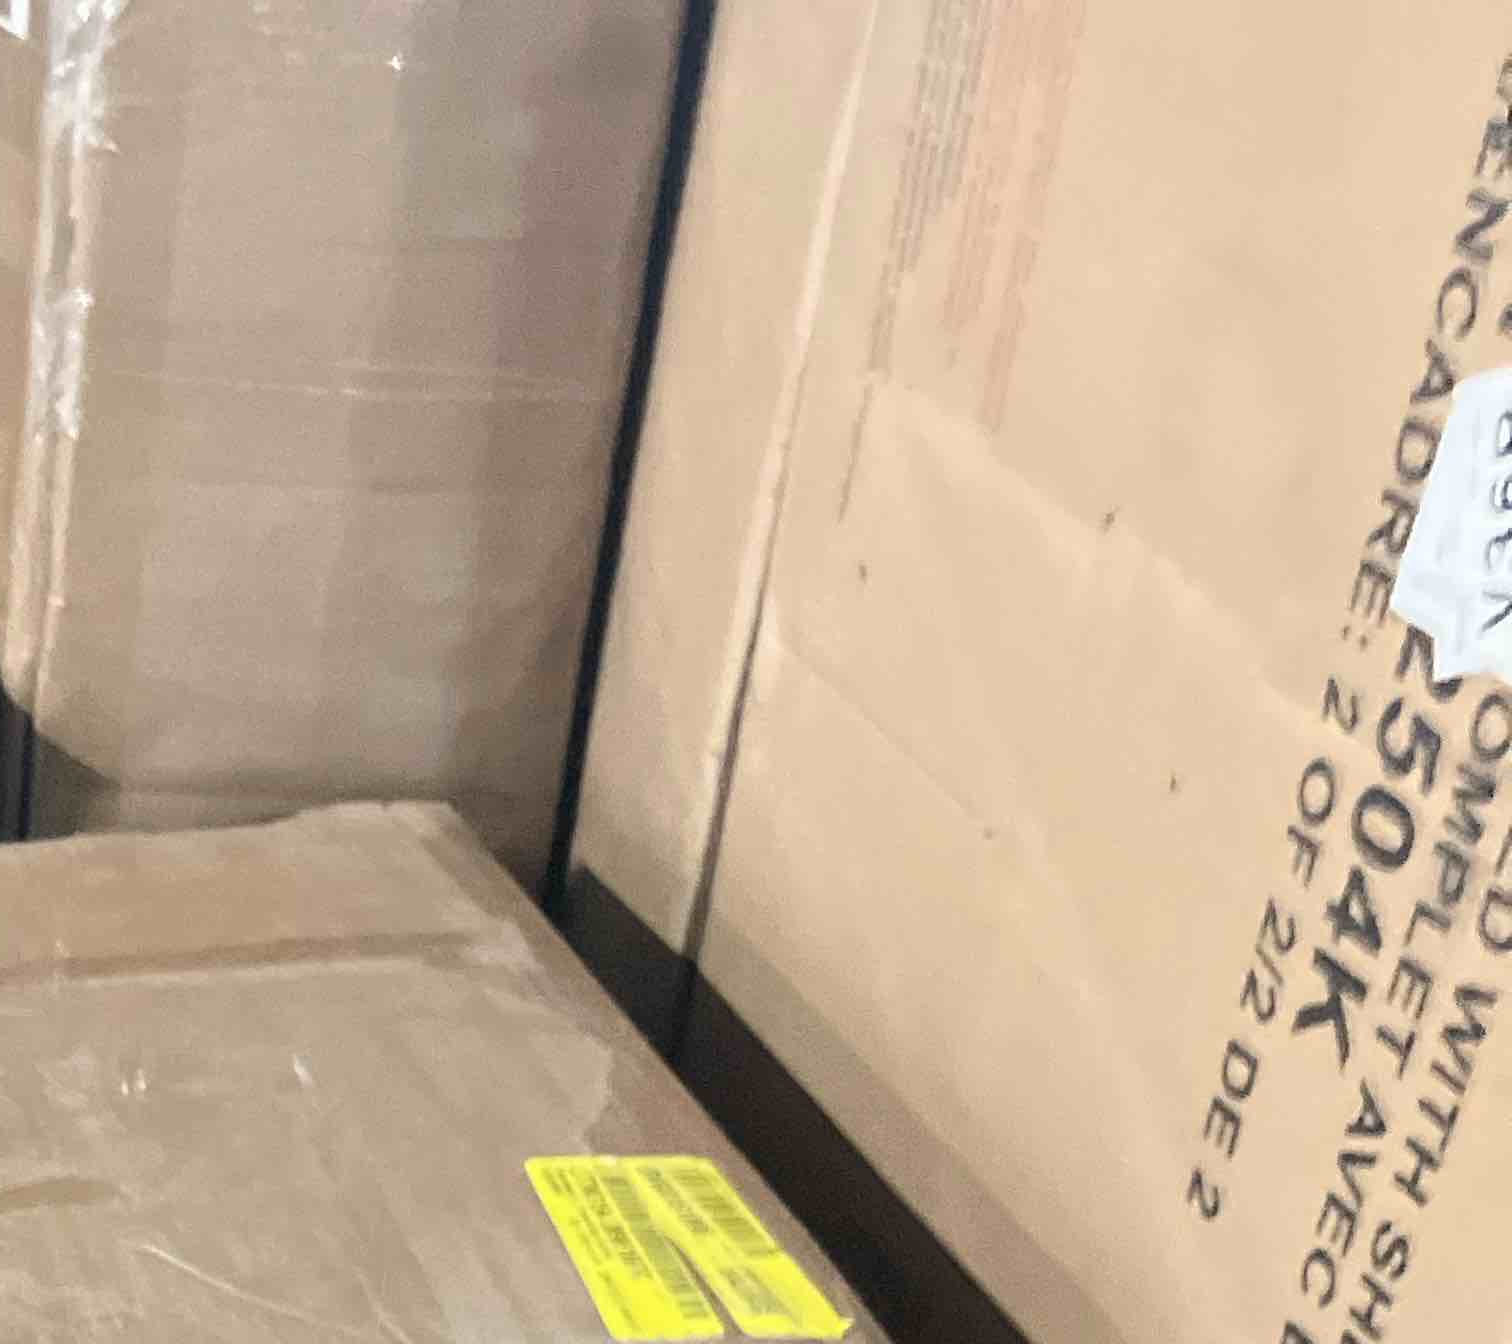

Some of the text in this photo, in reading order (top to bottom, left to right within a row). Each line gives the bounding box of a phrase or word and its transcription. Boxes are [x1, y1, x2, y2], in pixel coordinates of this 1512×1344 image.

[1322, 673, 1360, 735] 2
[1287, 756, 1337, 890] OF
[1376, 692, 1512, 1081] OMPLET
[1240, 898, 1297, 1024] 2/2
[1202, 1039, 1258, 1162] DE
[1394, 984, 1497, 1208] WITH
[1187, 1166, 1221, 1222] 2
[1301, 1077, 1387, 1308] AVEC
